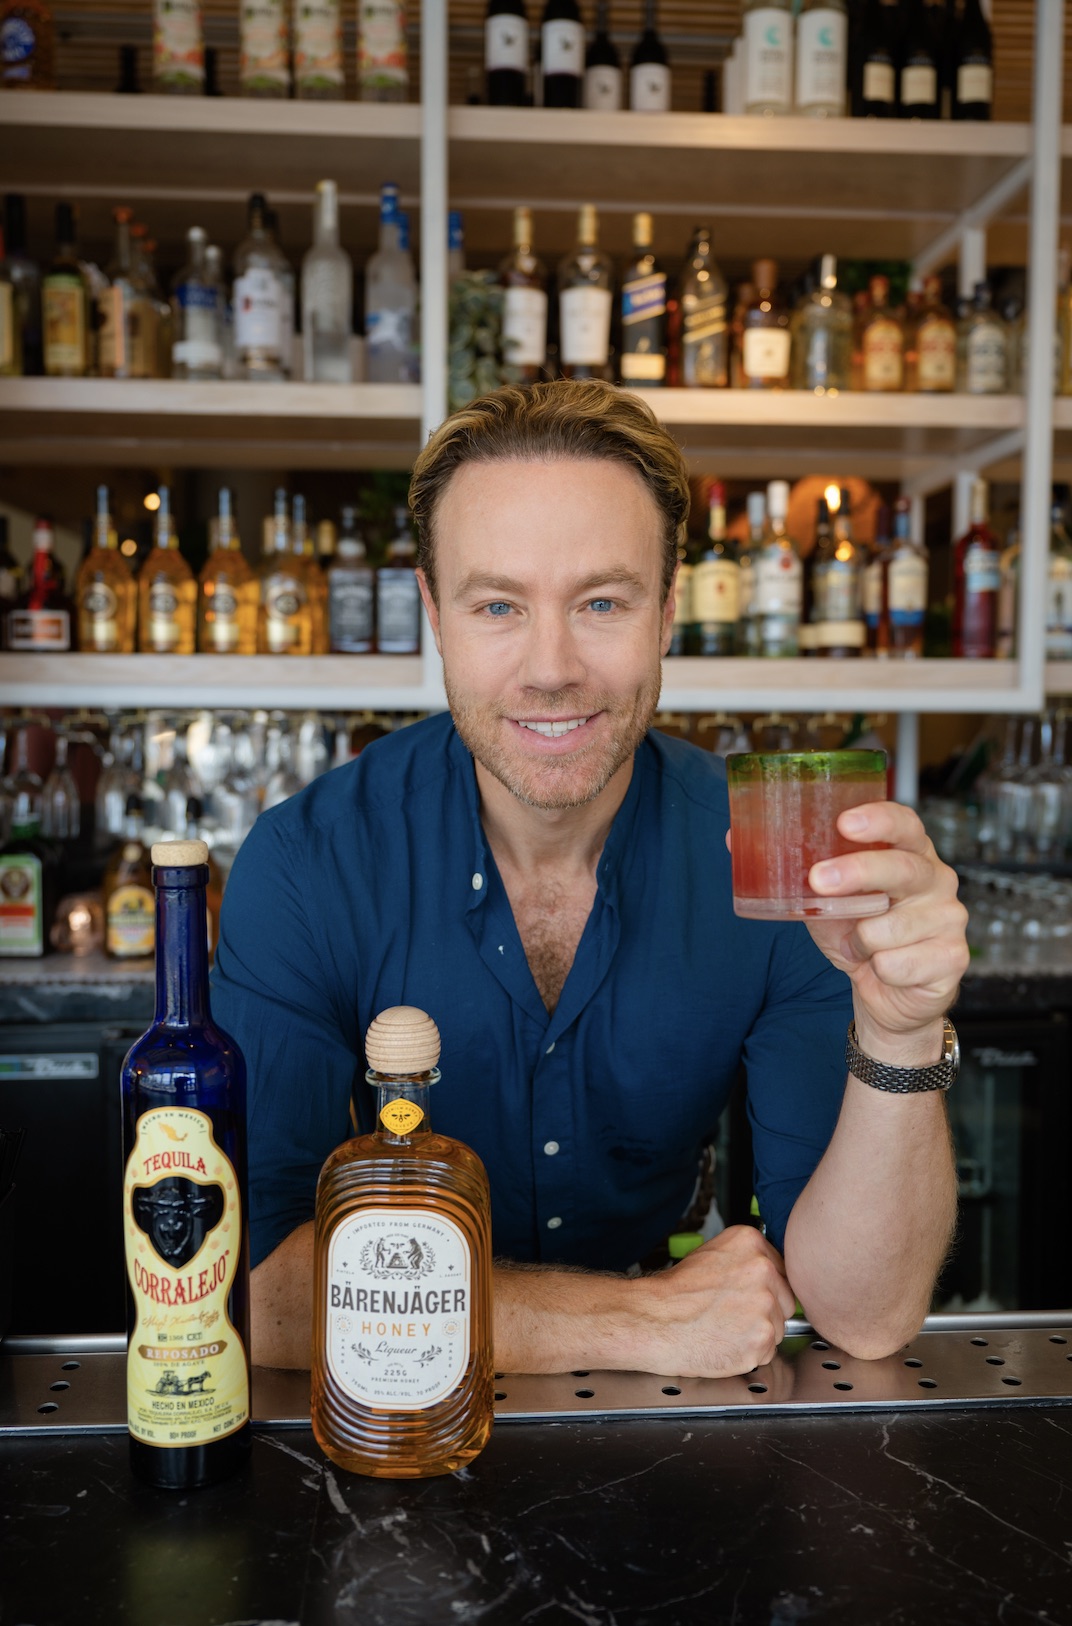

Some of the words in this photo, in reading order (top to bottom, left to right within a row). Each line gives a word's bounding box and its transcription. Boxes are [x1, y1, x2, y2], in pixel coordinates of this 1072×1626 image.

[143, 1151, 208, 1176] TEQUILA
[352, 1221, 386, 1235] IMPORTED
[412, 1223, 445, 1237] GERMANY
[133, 1254, 228, 1307] CORRALEJO
[331, 1281, 466, 1315] BÄRENJÄGER
[361, 1321, 432, 1337] HONEY
[146, 1344, 219, 1360] REPOSADO
[374, 1340, 417, 1357] Liqueur
[424, 1381, 441, 1394] PROOF
[152, 1401, 175, 1410] HECHO
[176, 1401, 186, 1410] EN
